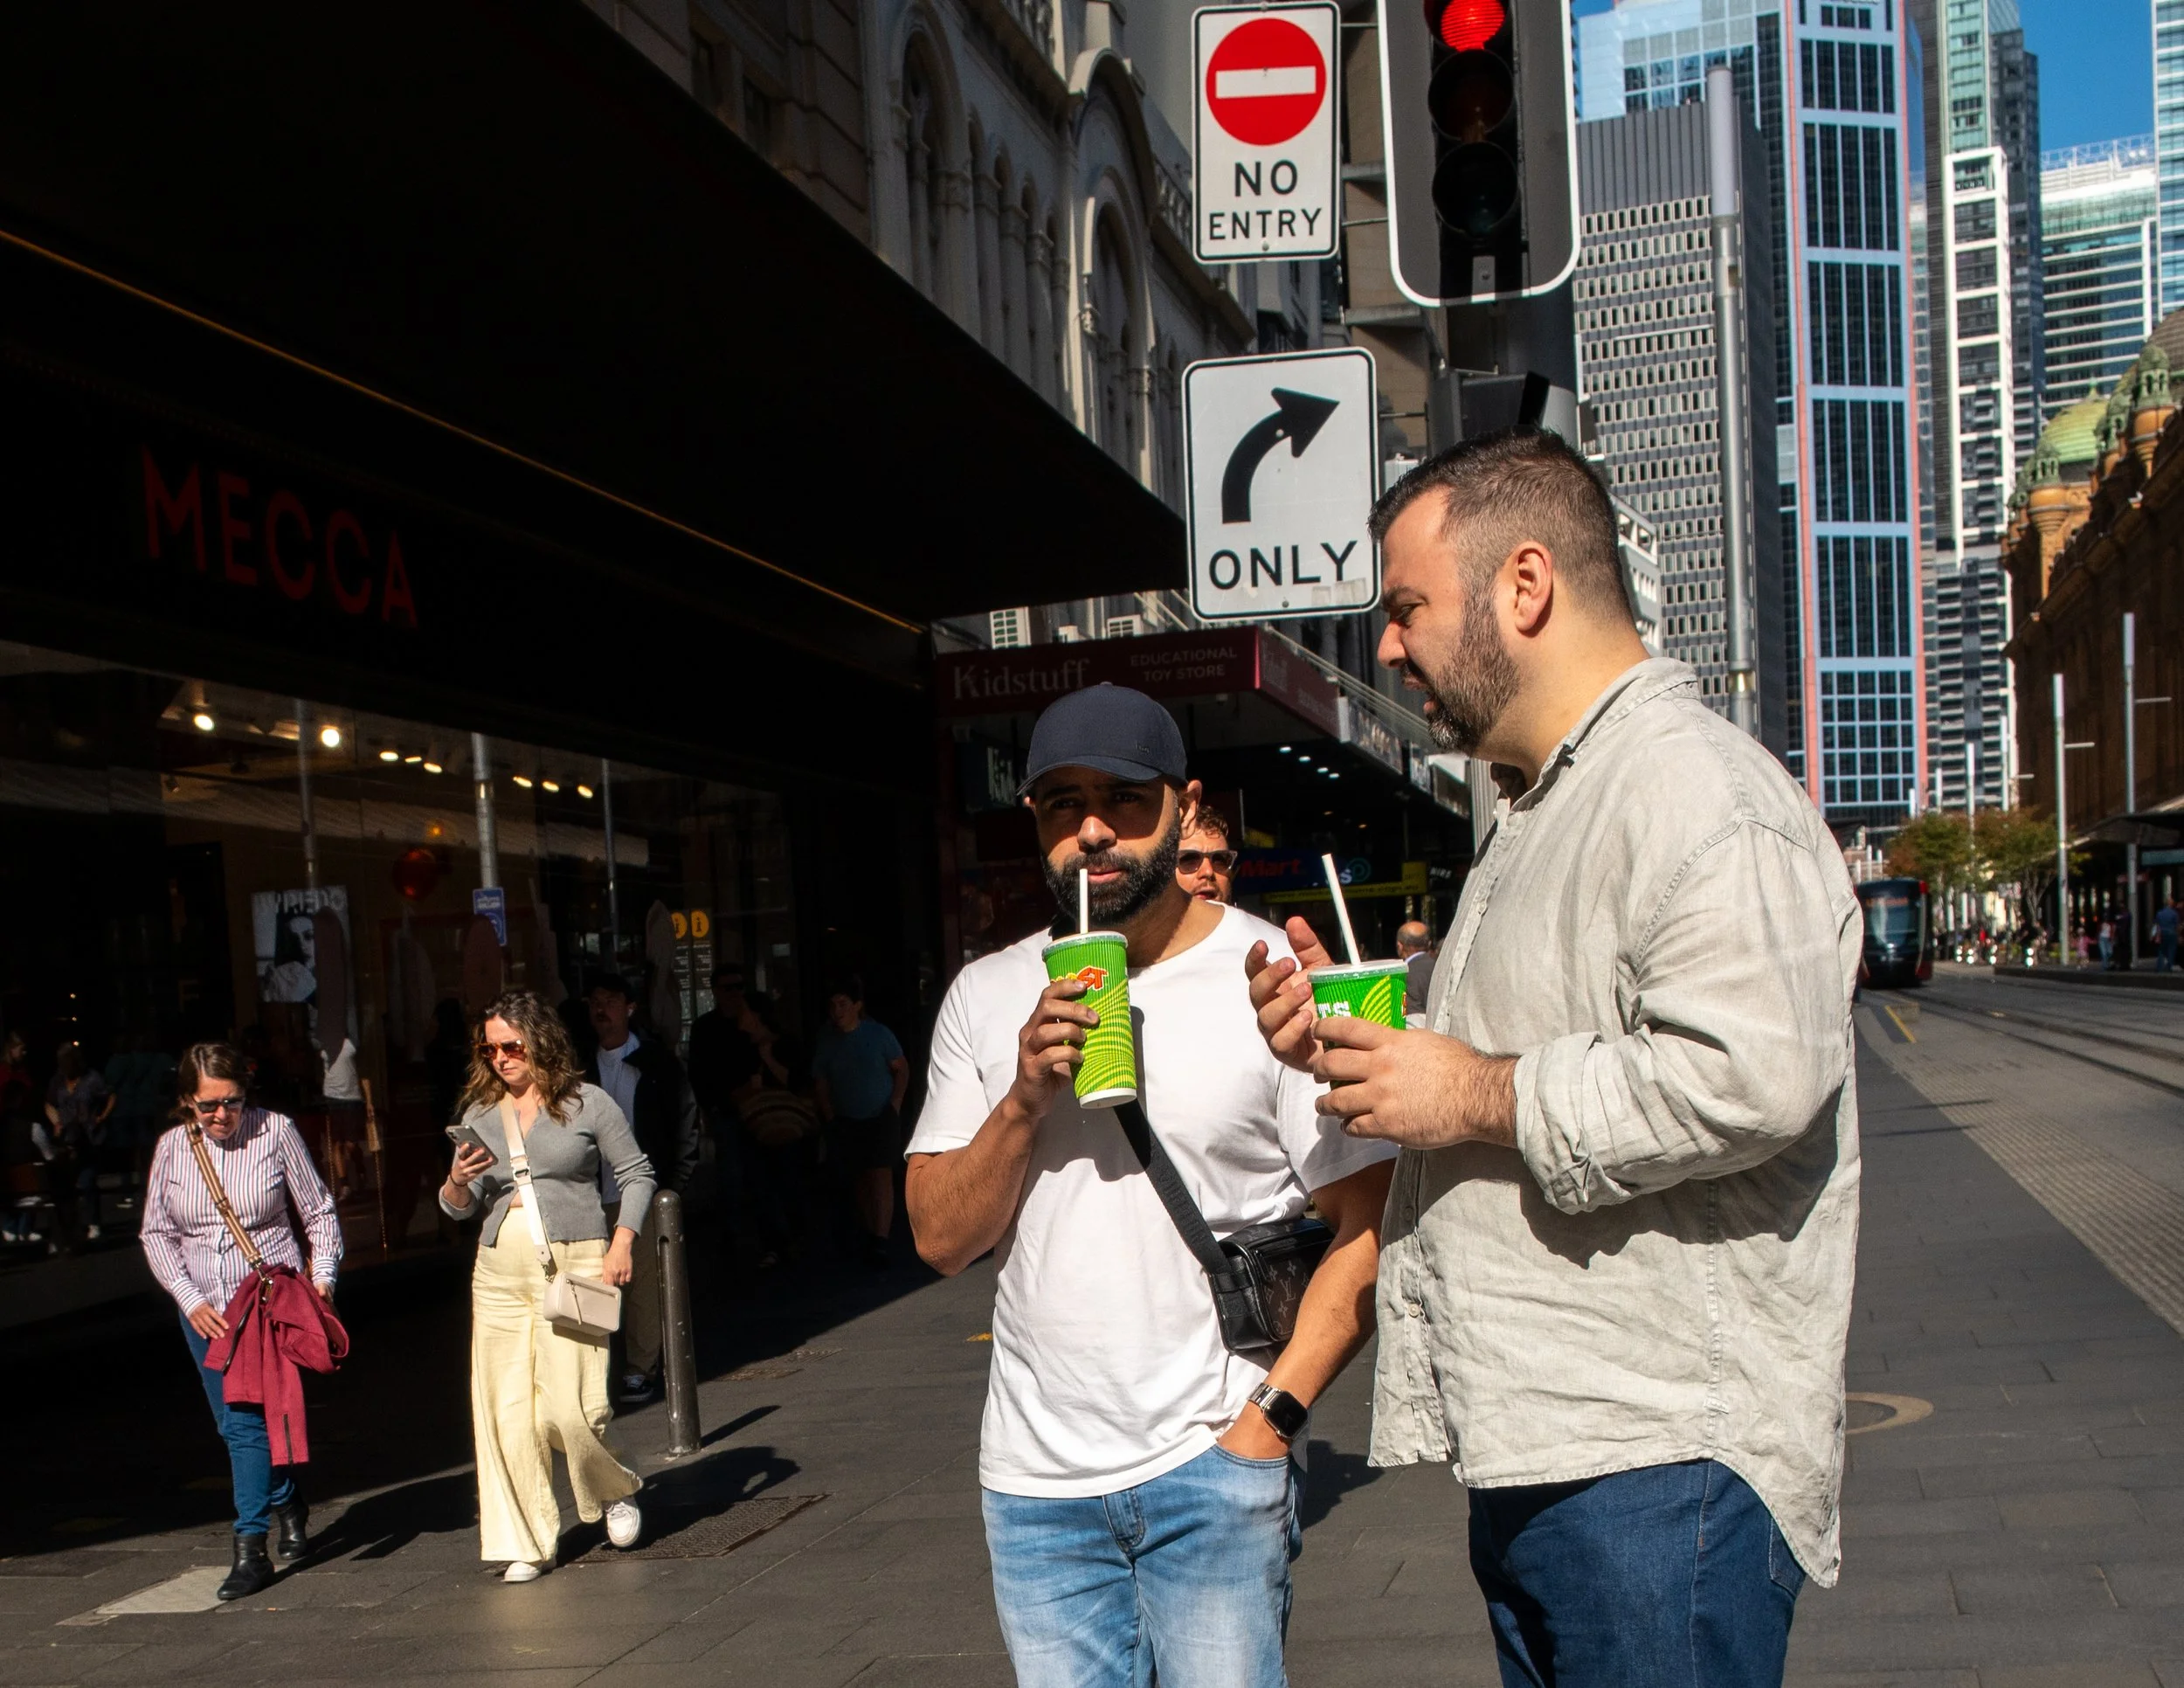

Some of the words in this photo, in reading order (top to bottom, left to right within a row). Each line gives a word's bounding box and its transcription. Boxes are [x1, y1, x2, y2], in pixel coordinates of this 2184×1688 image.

[1234, 160, 1298, 197] NO
[1209, 207, 1322, 240] ENTRY
[140, 440, 420, 633] MECCA
[1209, 539, 1358, 590] ONLY
[1130, 646, 1238, 668] EDUCATIONAL
[1143, 669, 1172, 683] TOY
[1176, 663, 1227, 681] STORE
[953, 657, 1091, 701] Kidstuff
